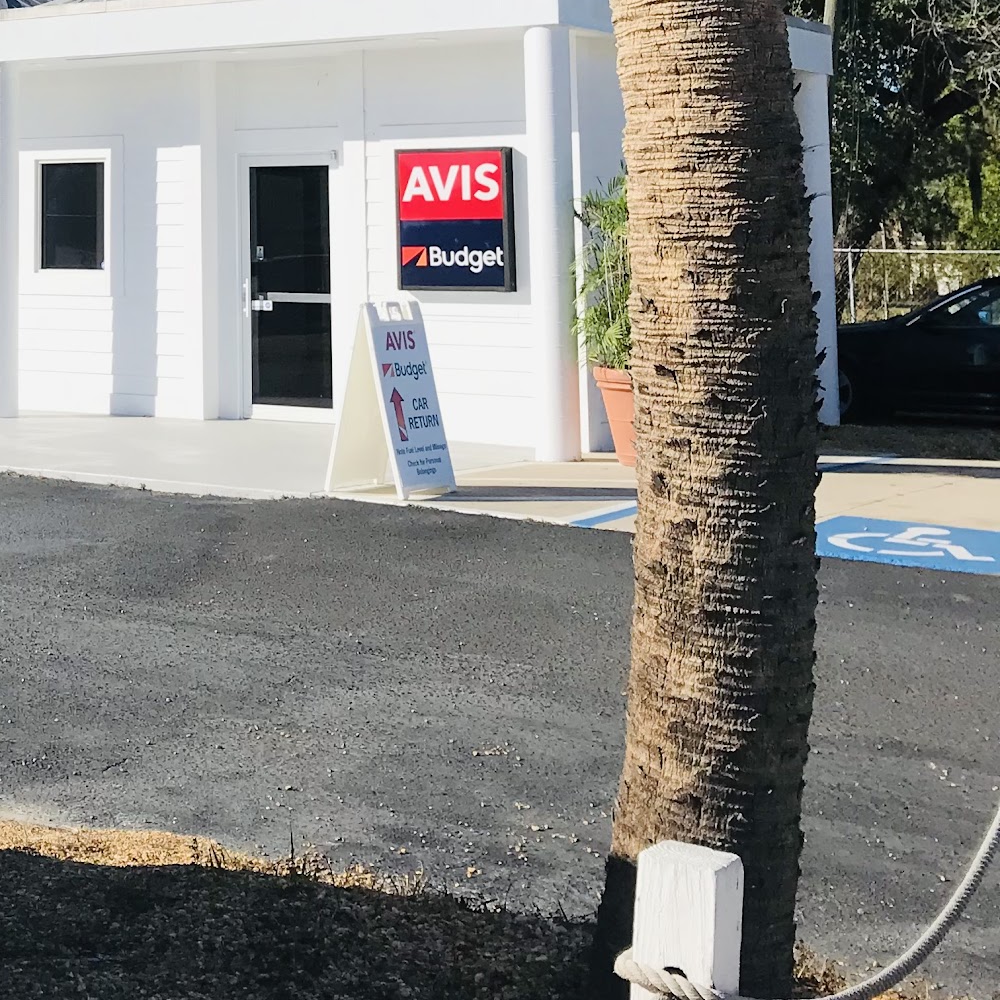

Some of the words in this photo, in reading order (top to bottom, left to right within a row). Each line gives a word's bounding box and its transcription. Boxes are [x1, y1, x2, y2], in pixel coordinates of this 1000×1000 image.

[402, 163, 500, 202] AVIS
[429, 246, 504, 273] Budget
[386, 330, 416, 351] AVIS
[394, 361, 427, 381] Budget
[412, 397, 429, 411] CAR
[408, 414, 440, 430] RETURN
